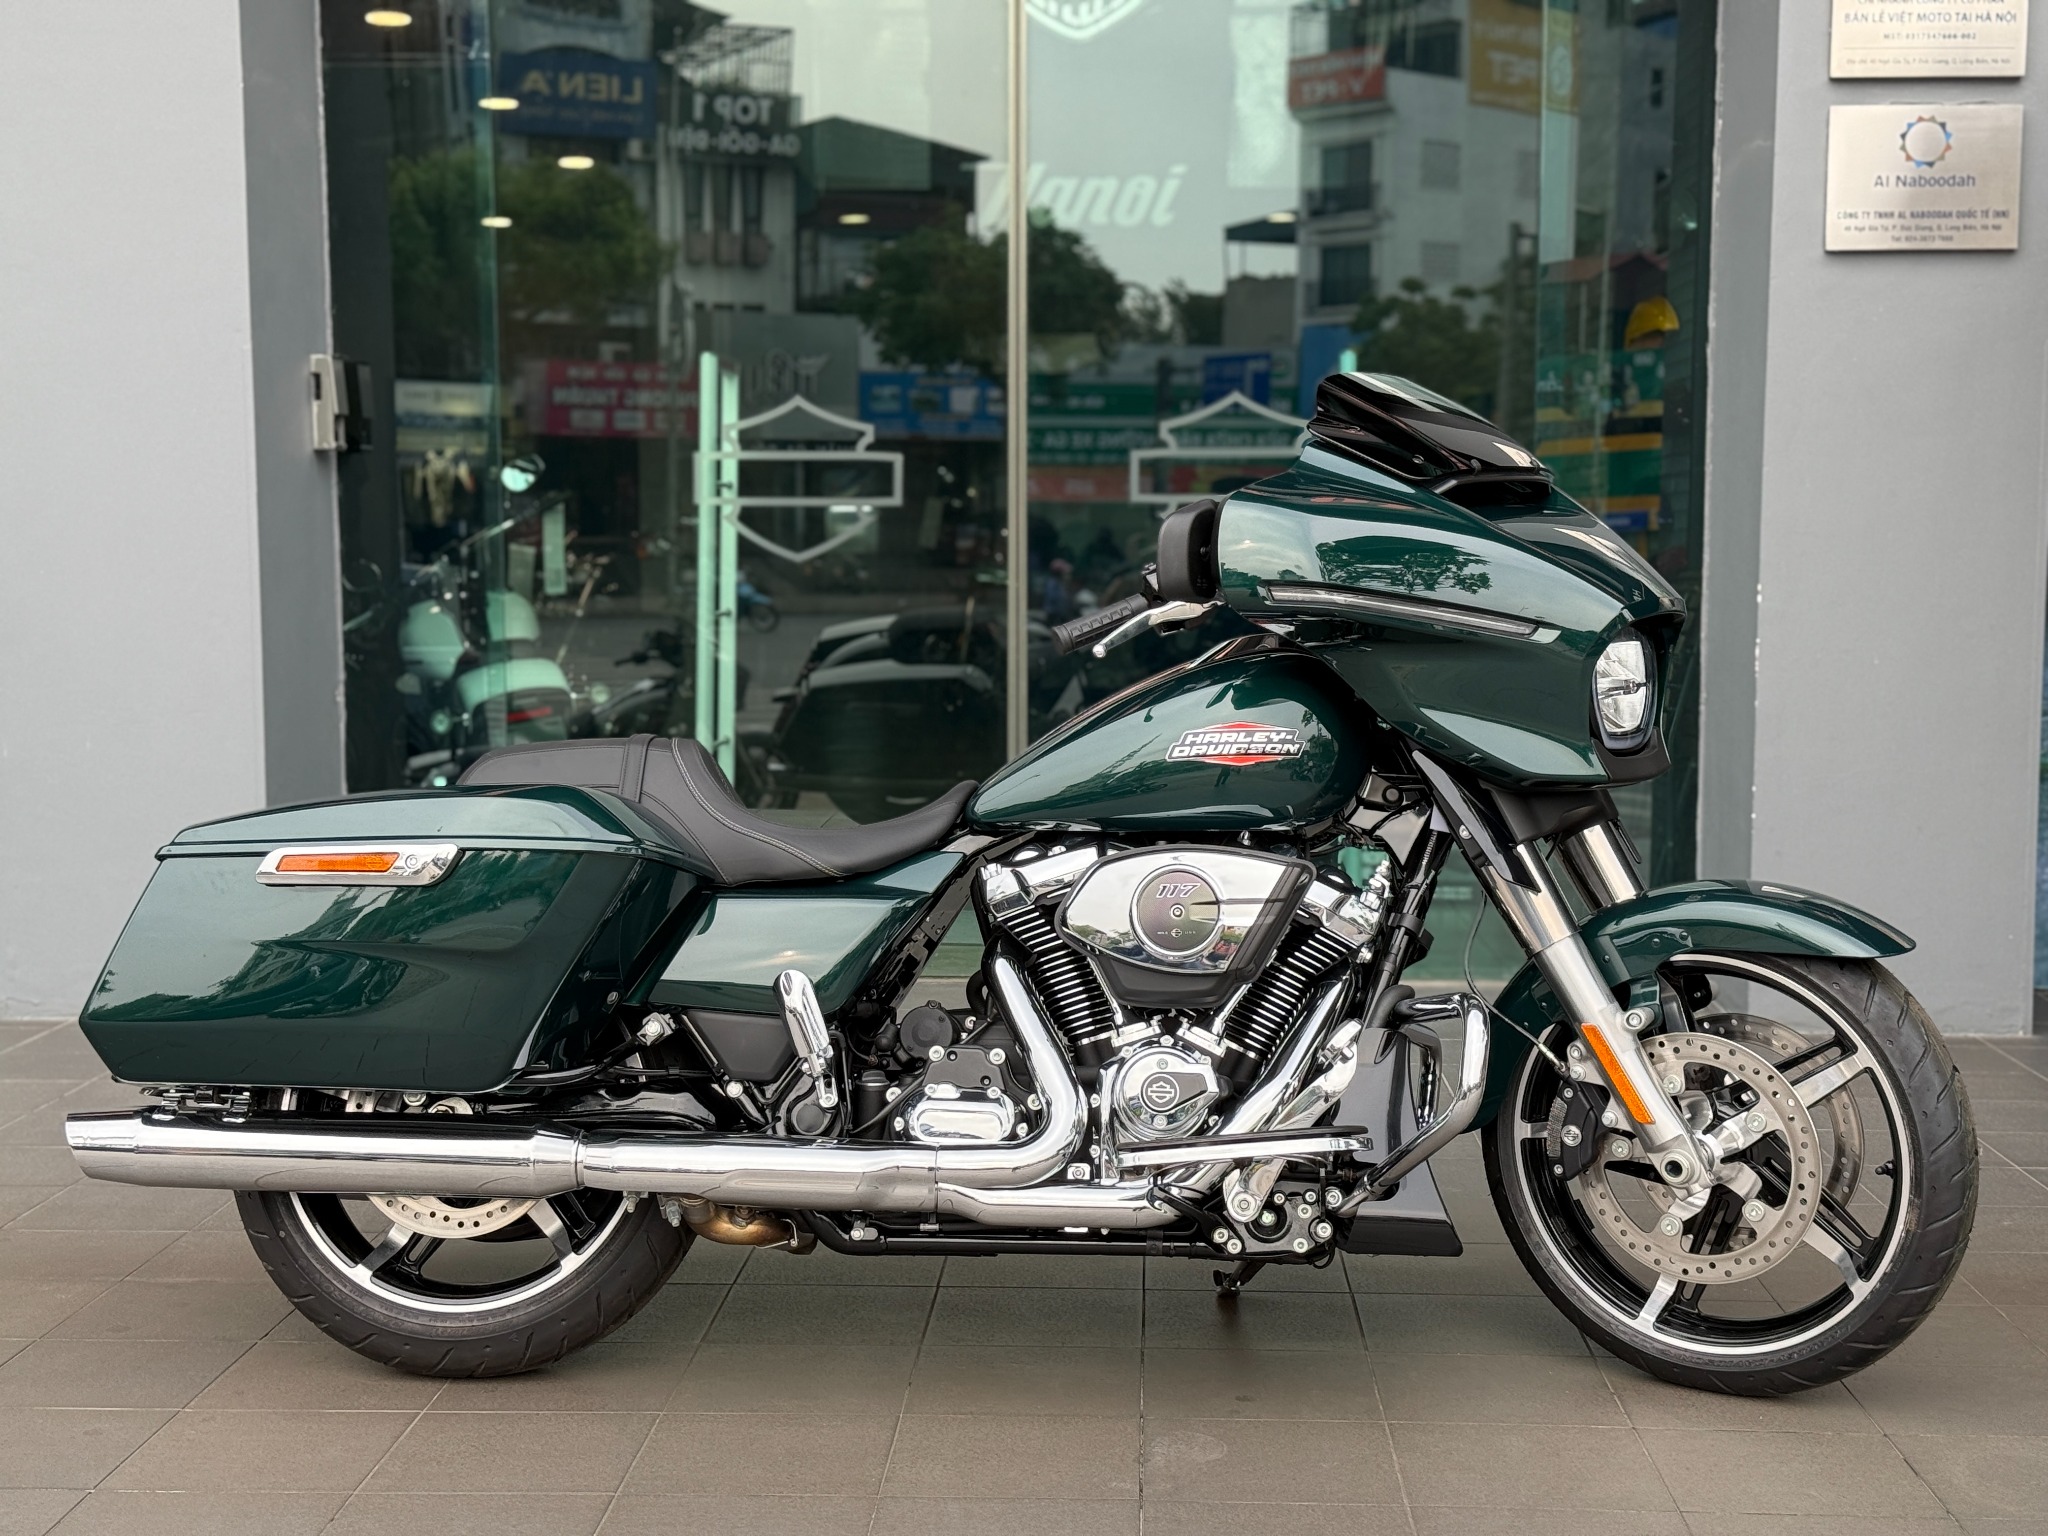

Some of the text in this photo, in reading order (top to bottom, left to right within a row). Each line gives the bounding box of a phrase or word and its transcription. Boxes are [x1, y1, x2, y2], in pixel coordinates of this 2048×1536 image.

[1916, 12, 1952, 23] MOTO
[1874, 174, 1976, 188] Al Naboodah
[1862, 210, 1871, 219] TY
[1910, 210, 1953, 219] NABOODAH
[1185, 731, 1293, 745] HARLEY-
[1171, 743, 1301, 758] DAVIDSON
[1156, 883, 1200, 899] 117
